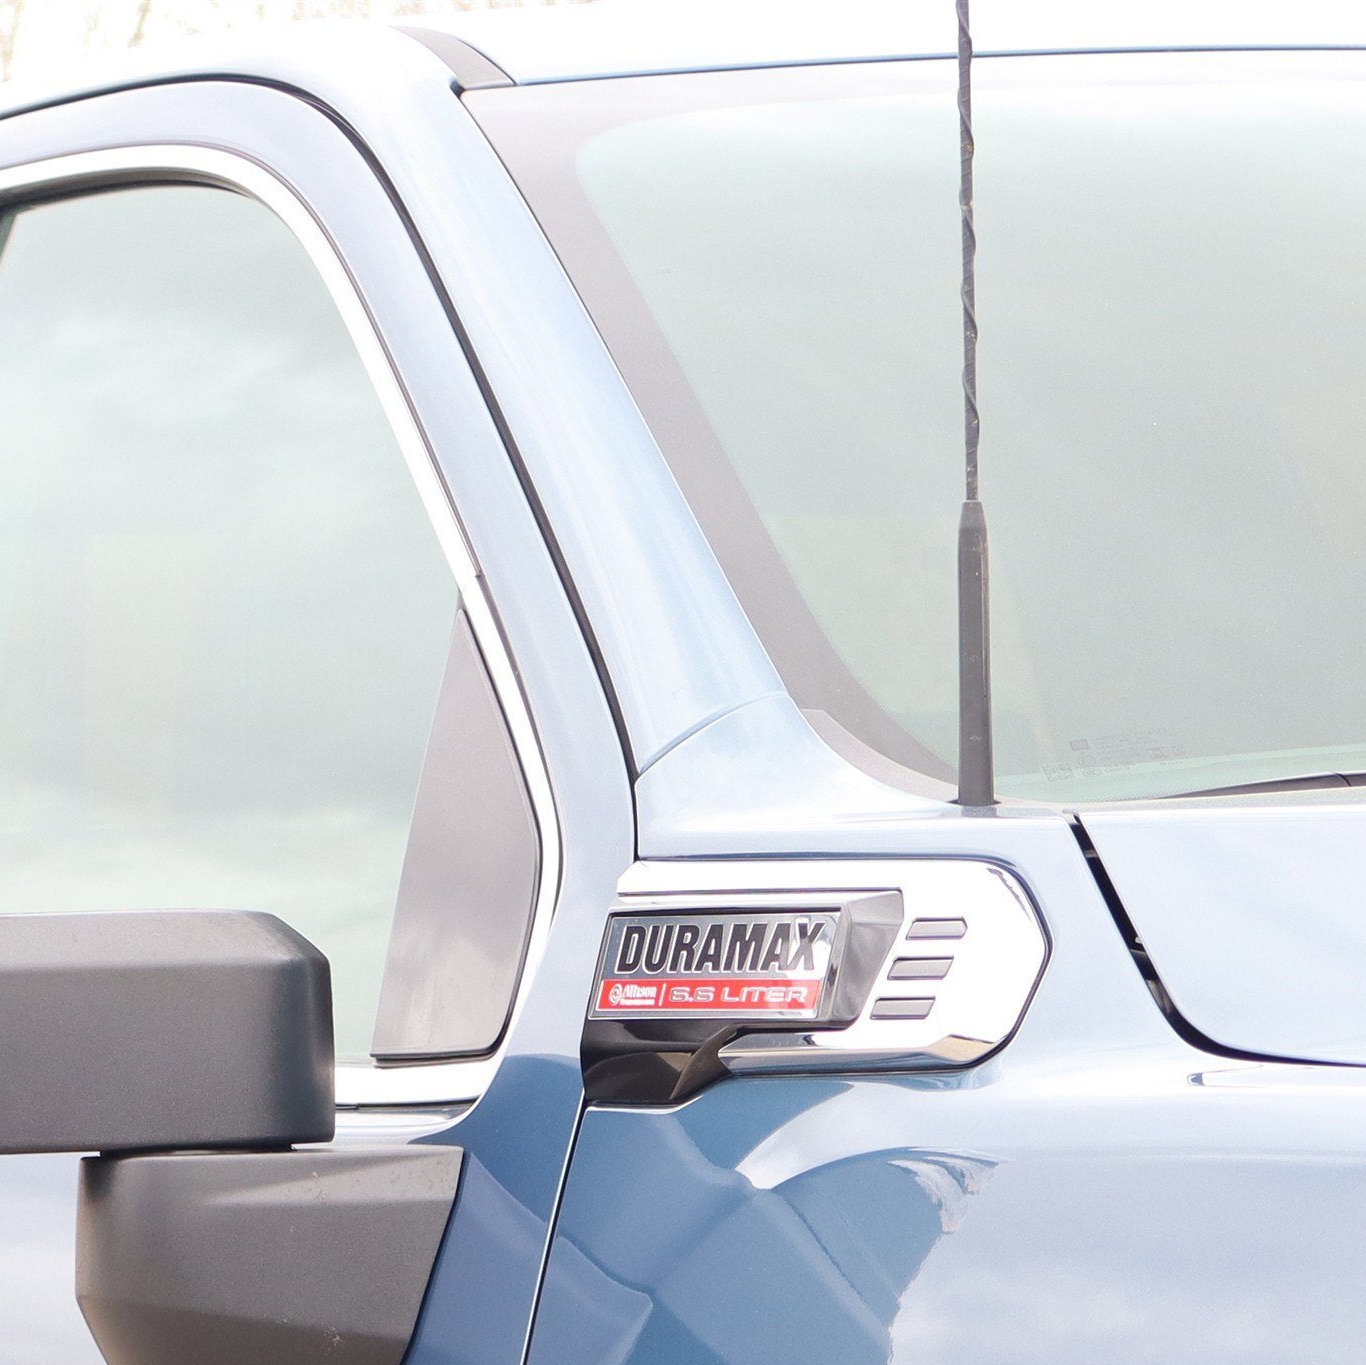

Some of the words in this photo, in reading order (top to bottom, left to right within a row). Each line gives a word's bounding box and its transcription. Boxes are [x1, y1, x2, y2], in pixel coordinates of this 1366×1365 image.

[614, 921, 826, 974] DURAMAX
[669, 986, 715, 1003] 6.6
[722, 986, 808, 1003] LITER
